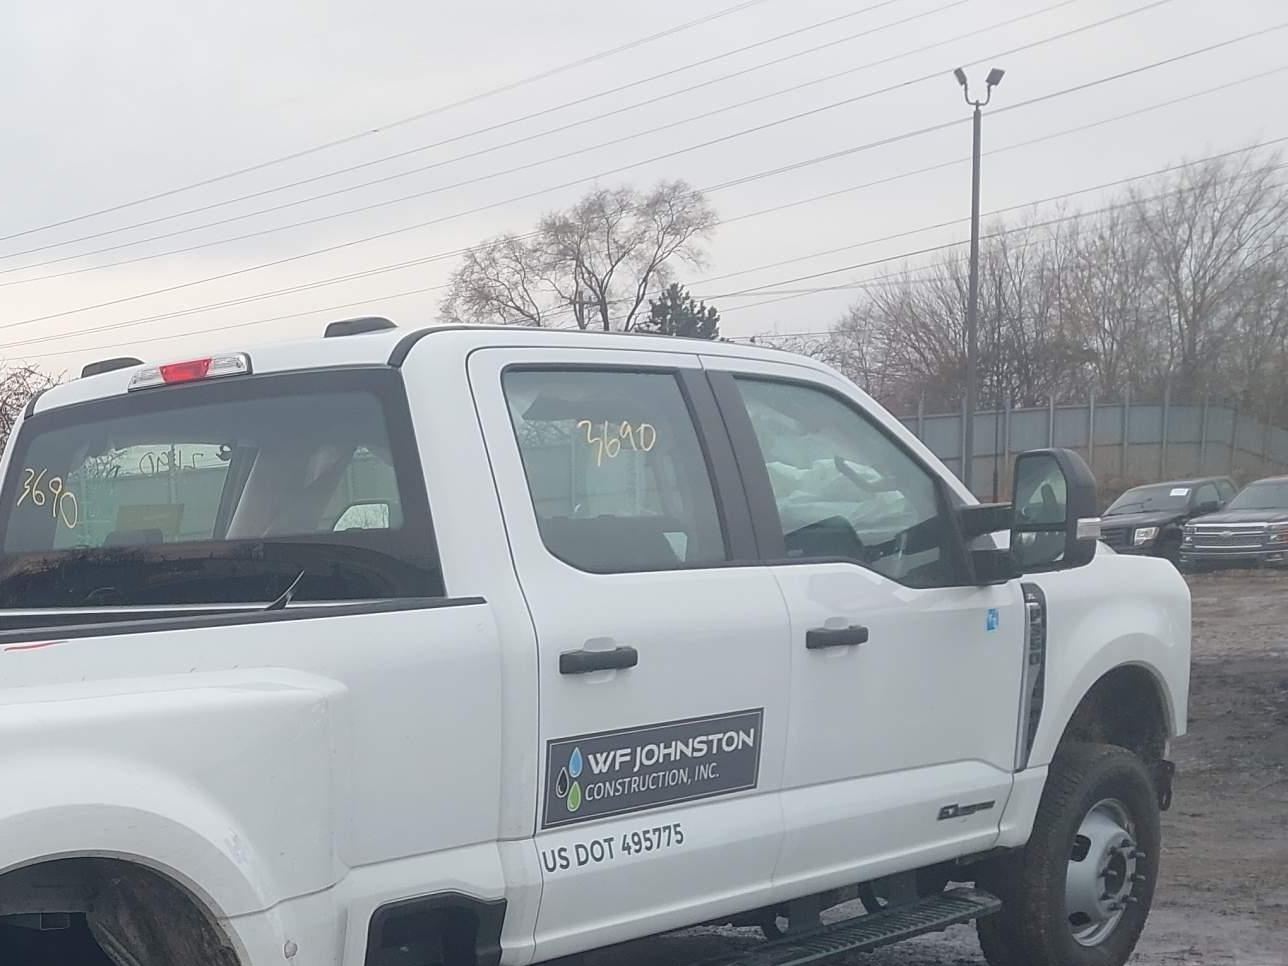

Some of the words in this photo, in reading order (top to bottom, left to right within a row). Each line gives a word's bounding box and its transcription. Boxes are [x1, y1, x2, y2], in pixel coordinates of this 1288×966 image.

[576, 420, 656, 466] 3690
[16, 468, 78, 529] 3690
[587, 748, 632, 774] WF
[634, 728, 755, 772] JOHNSTON
[585, 767, 692, 801] CONSTRUCTION,
[694, 762, 720, 779] INC.
[542, 847, 570, 872] US
[575, 837, 615, 866] DOT
[621, 823, 685, 856] 495775
